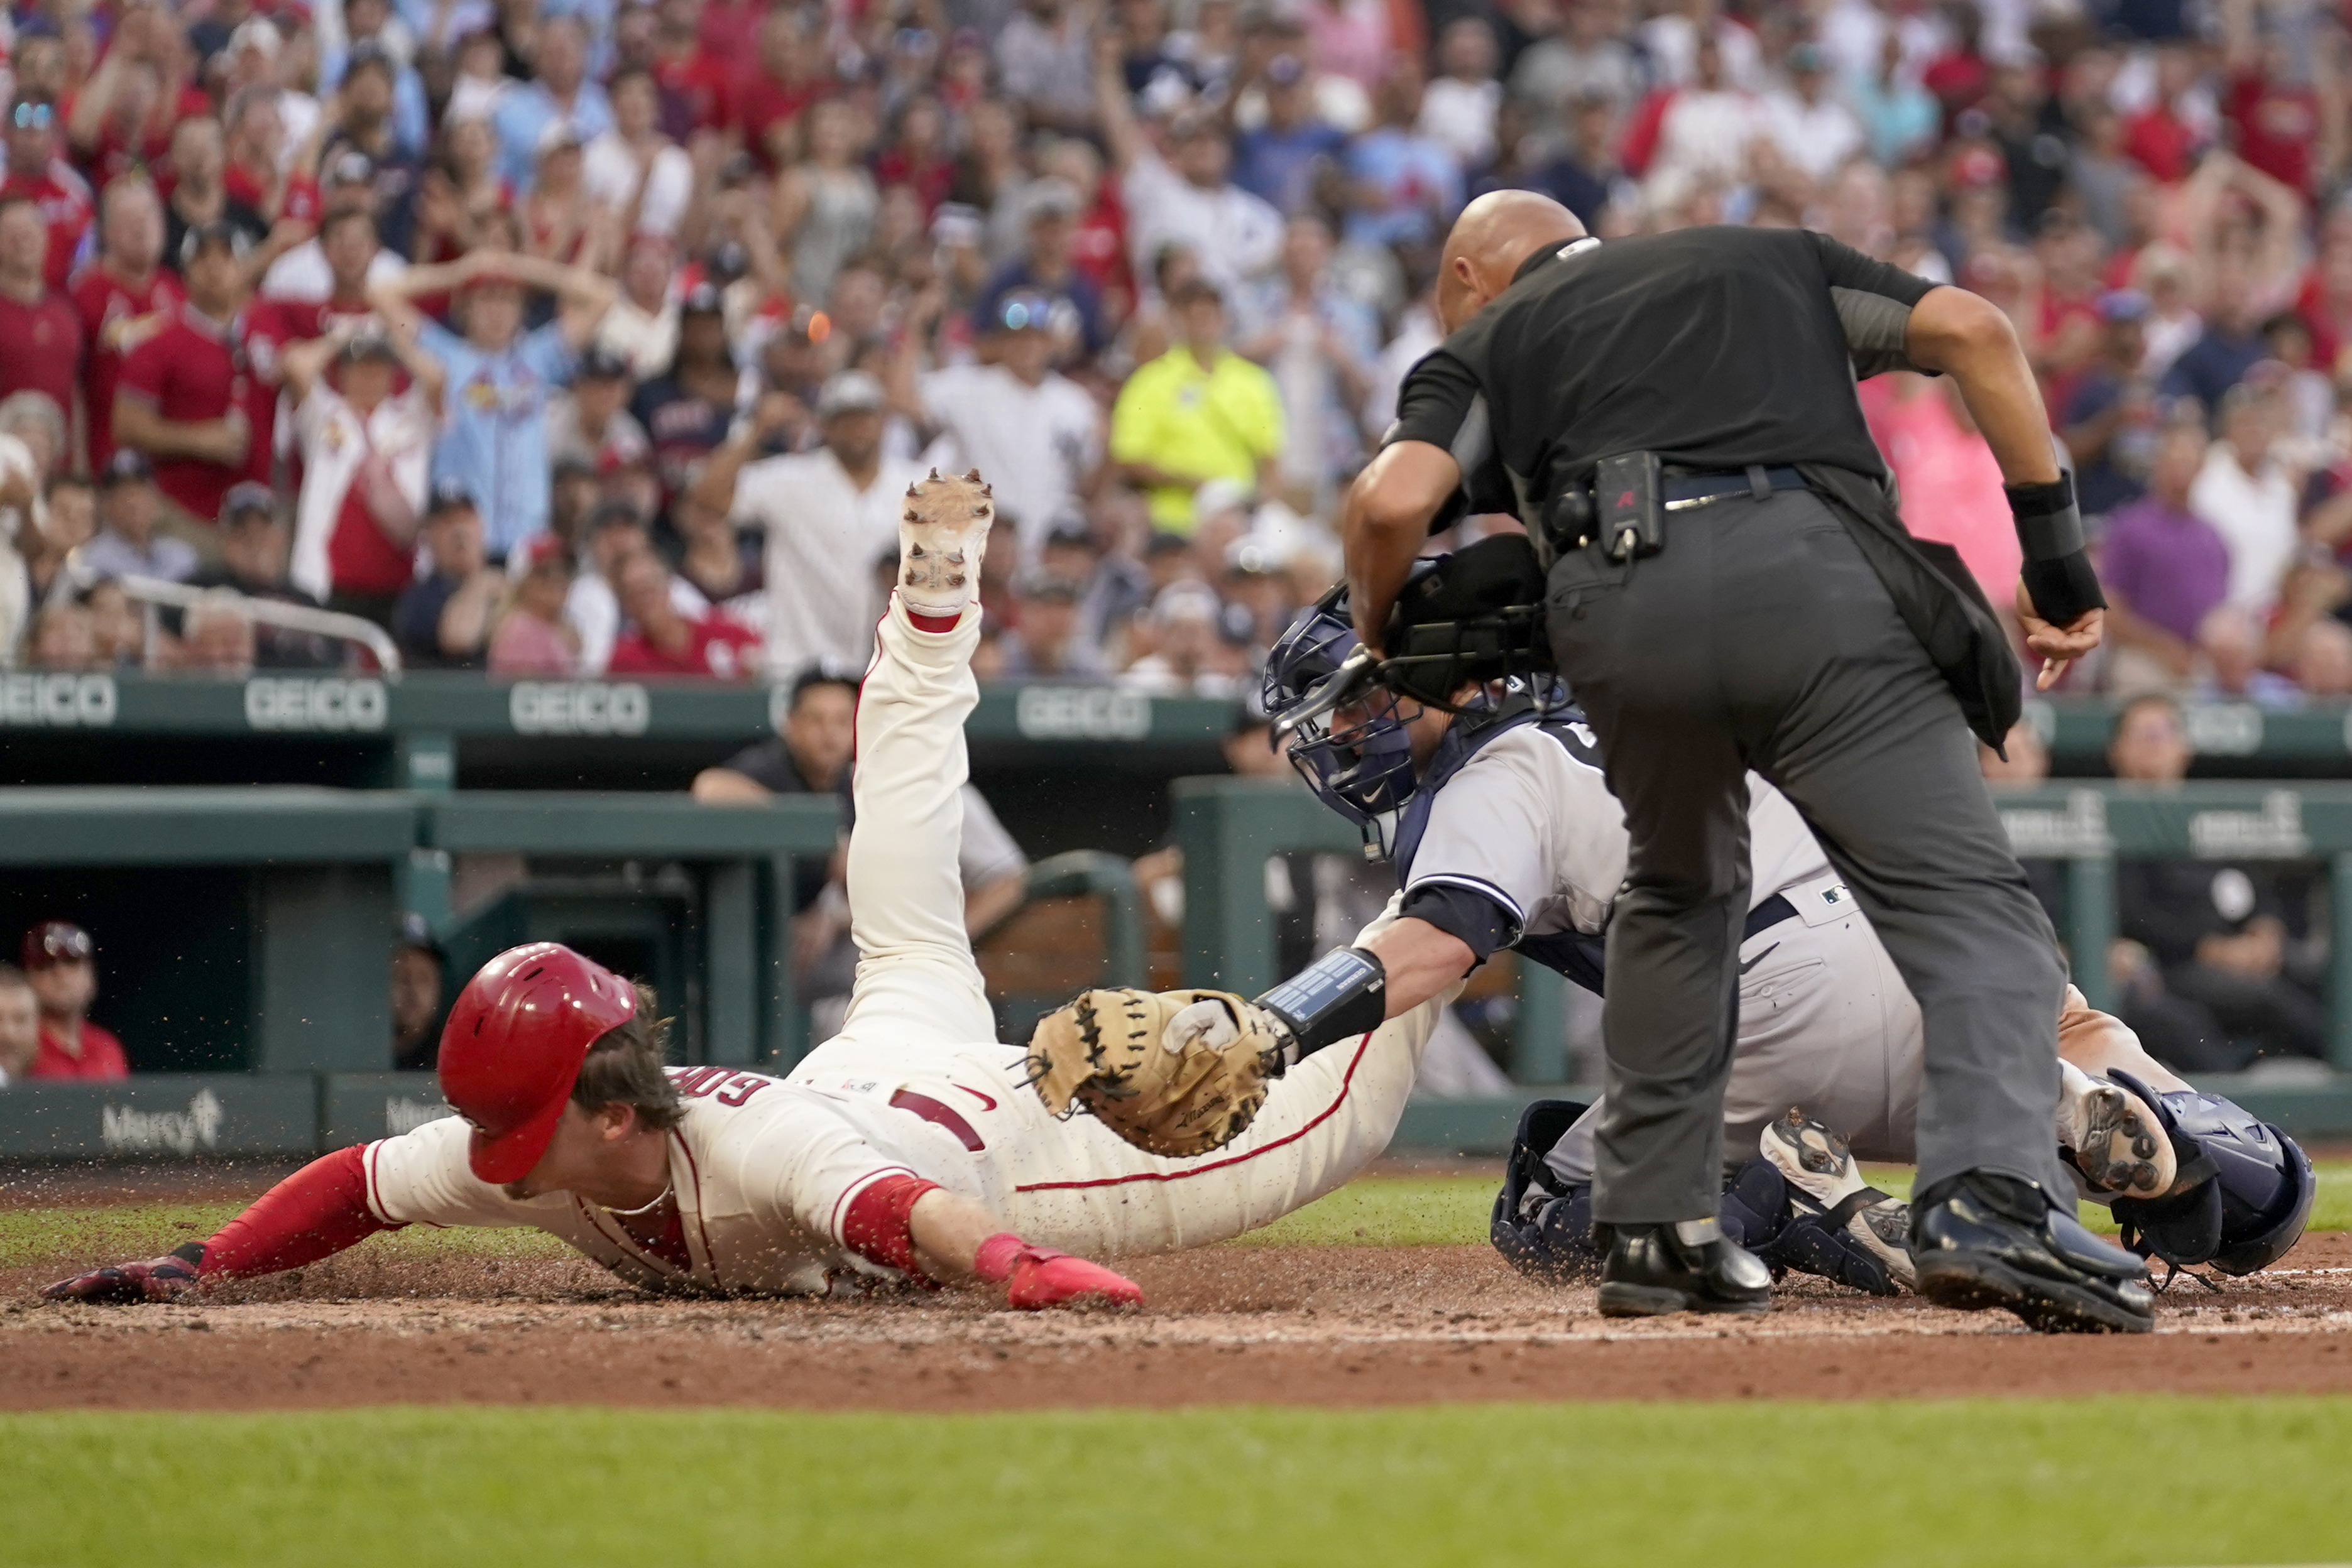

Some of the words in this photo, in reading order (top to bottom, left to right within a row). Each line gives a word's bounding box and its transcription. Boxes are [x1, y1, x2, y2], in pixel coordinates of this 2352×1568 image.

[244, 677, 387, 731] GEICO
[509, 681, 650, 737] GEICO
[1017, 687, 1151, 739] GEICO
[667, 1066, 770, 1108] GOR
[102, 1103, 195, 1156] Mercy
